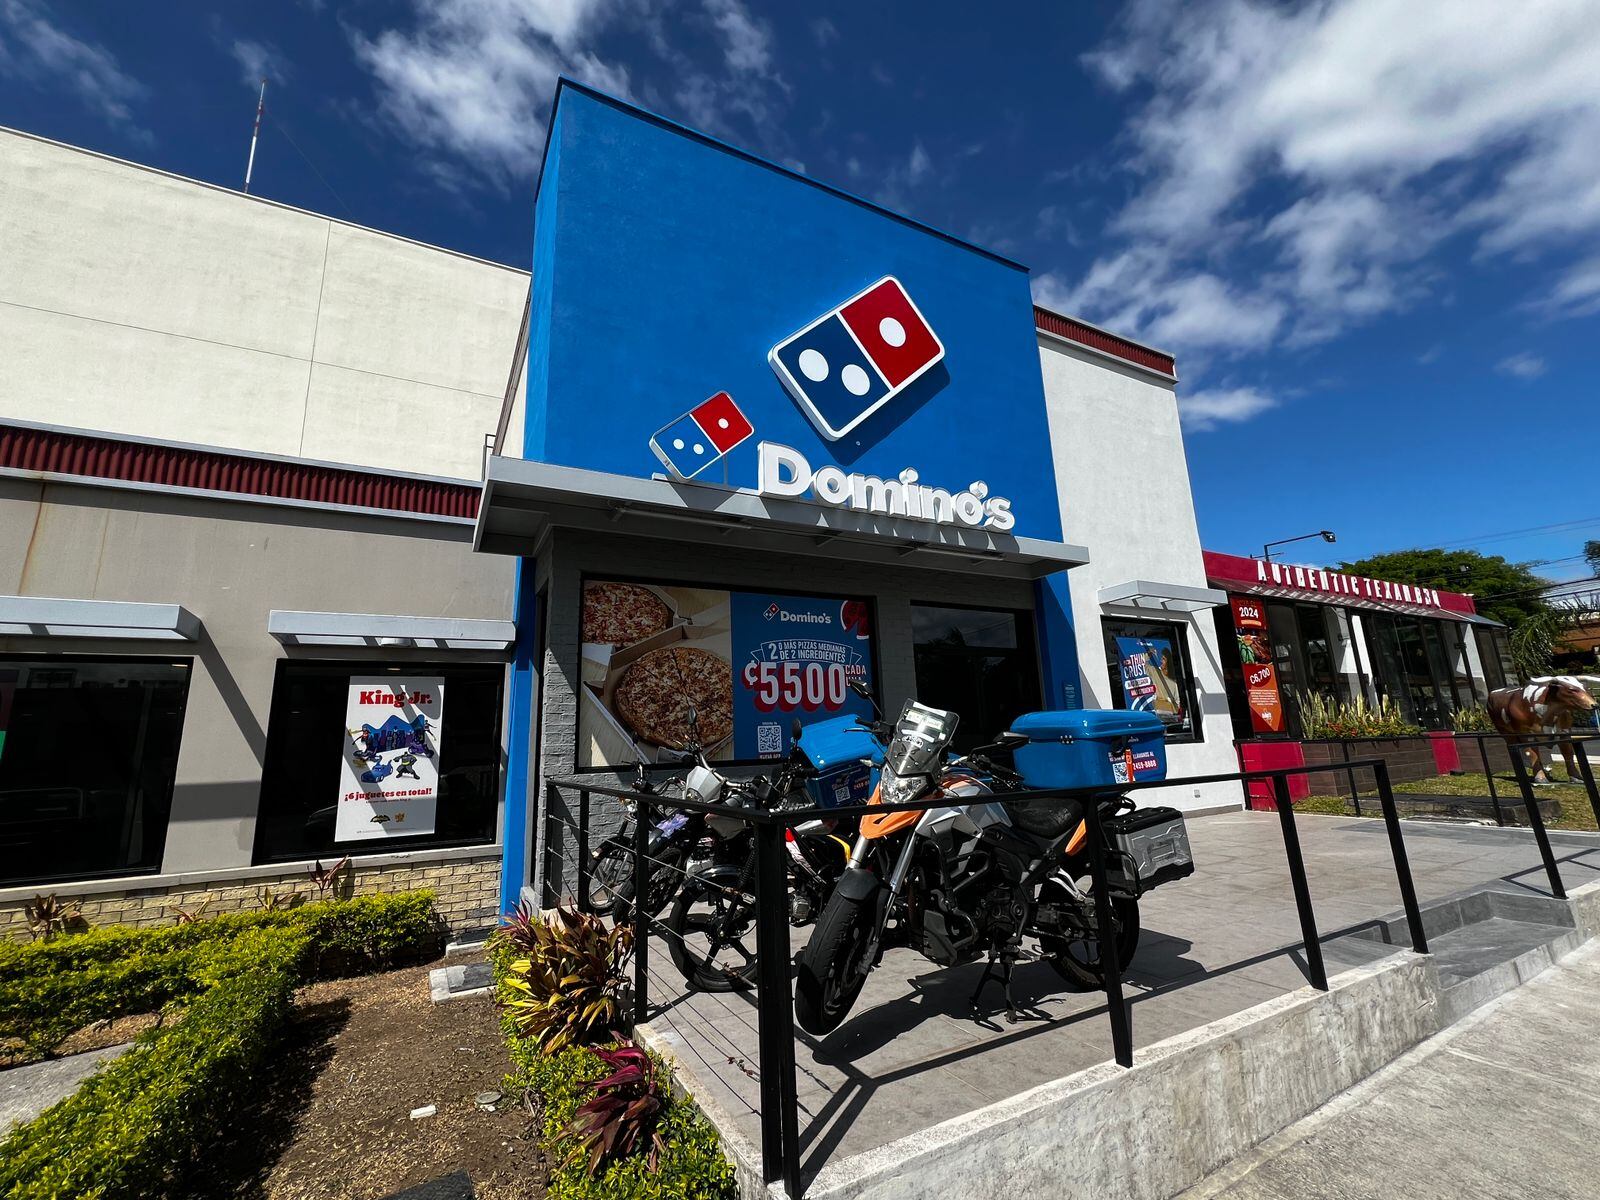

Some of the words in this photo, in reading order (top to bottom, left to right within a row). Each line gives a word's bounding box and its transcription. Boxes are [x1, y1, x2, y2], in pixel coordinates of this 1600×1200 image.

[757, 440, 1015, 530] Domino's
[1257, 560, 1359, 595] AUTHENTIC
[1363, 578, 1411, 602] TEXAN
[780, 610, 832, 624] Domino's
[1239, 606, 1259, 619] 2024
[768, 643, 778, 660] 2
[783, 640, 796, 650] MÁS
[798, 641, 817, 650] PIZZAS
[818, 643, 846, 653] MEDIANAS
[780, 650, 789, 660] DE
[791, 650, 796, 659] 2
[798, 649, 846, 663] INGREDIENTES
[1129, 653, 1146, 665] THIN
[845, 664, 866, 675] CADA
[1123, 664, 1146, 679] CRUST
[359, 690, 407, 708] King
[408, 691, 433, 704] Jr.
[355, 790, 394, 800] juguetes
[408, 788, 432, 796] total!
